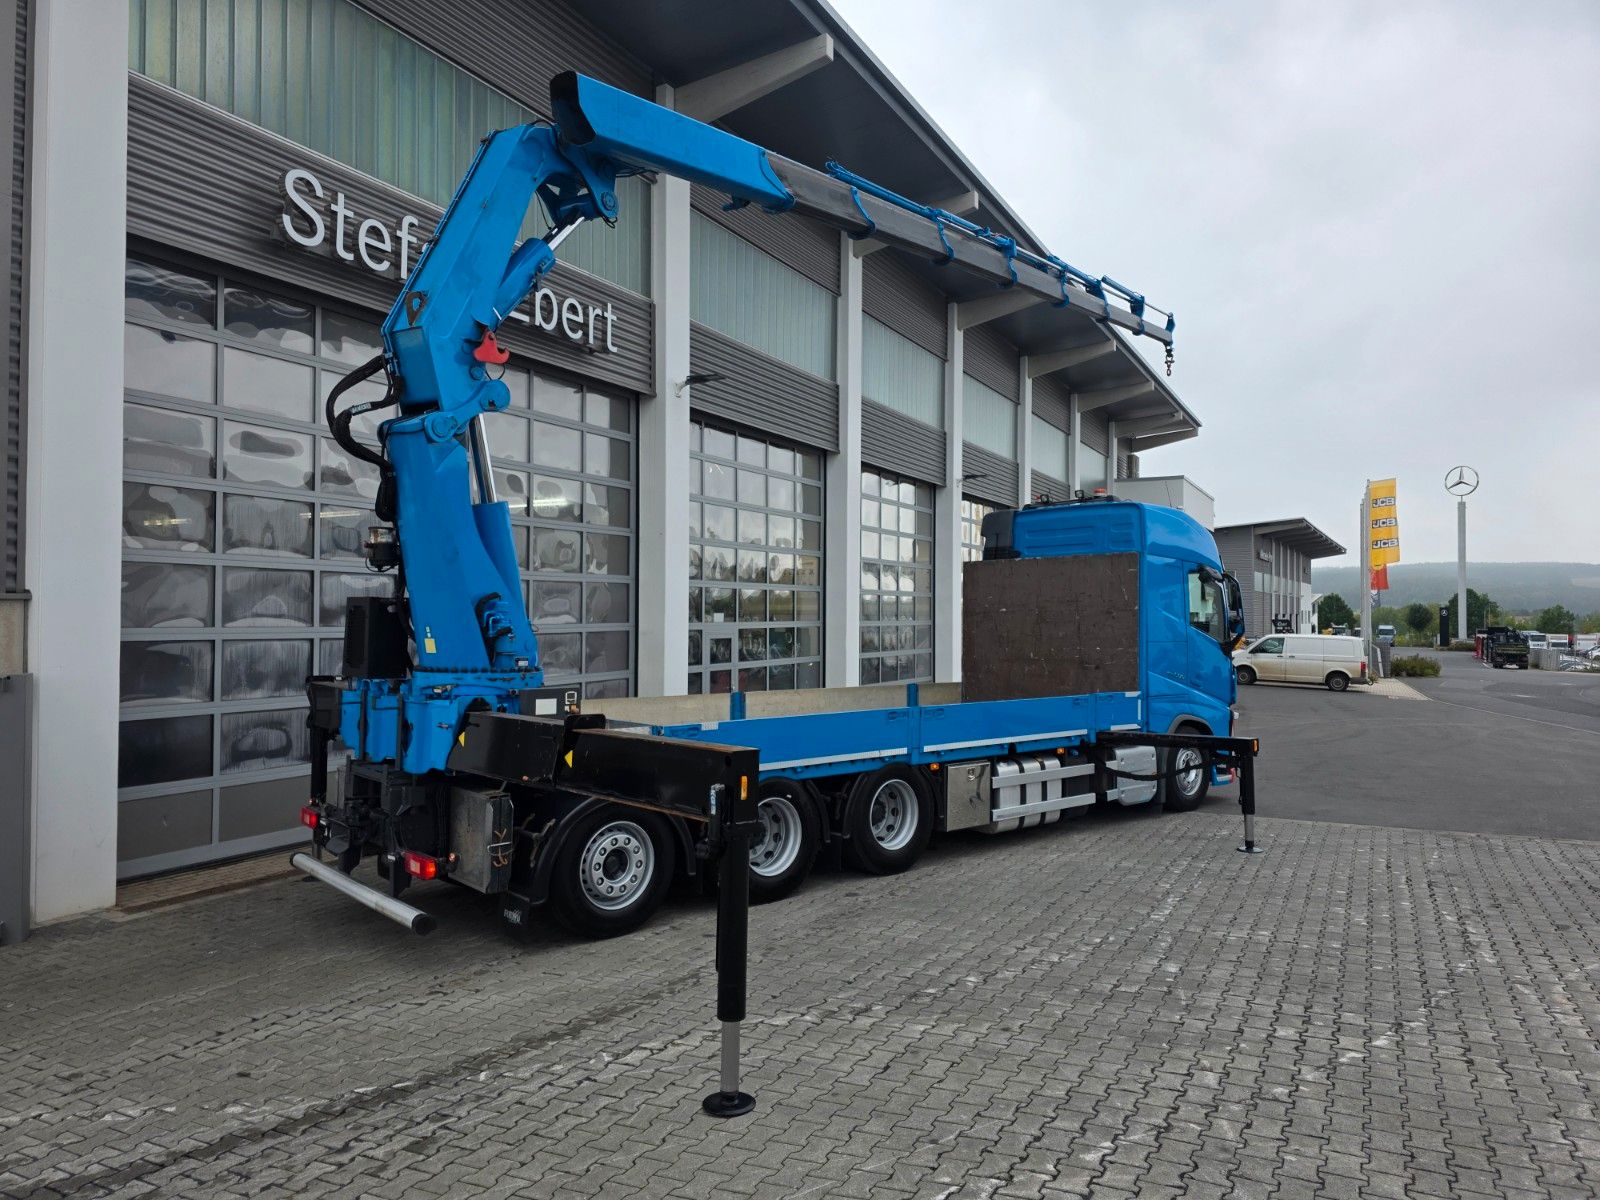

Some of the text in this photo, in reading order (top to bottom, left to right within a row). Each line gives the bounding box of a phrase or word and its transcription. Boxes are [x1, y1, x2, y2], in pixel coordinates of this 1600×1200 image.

[282, 169, 618, 353] Stef bert
[1372, 497, 1396, 508] JCB
[1372, 518, 1398, 528] JCB
[1372, 538, 1399, 549] JCB
